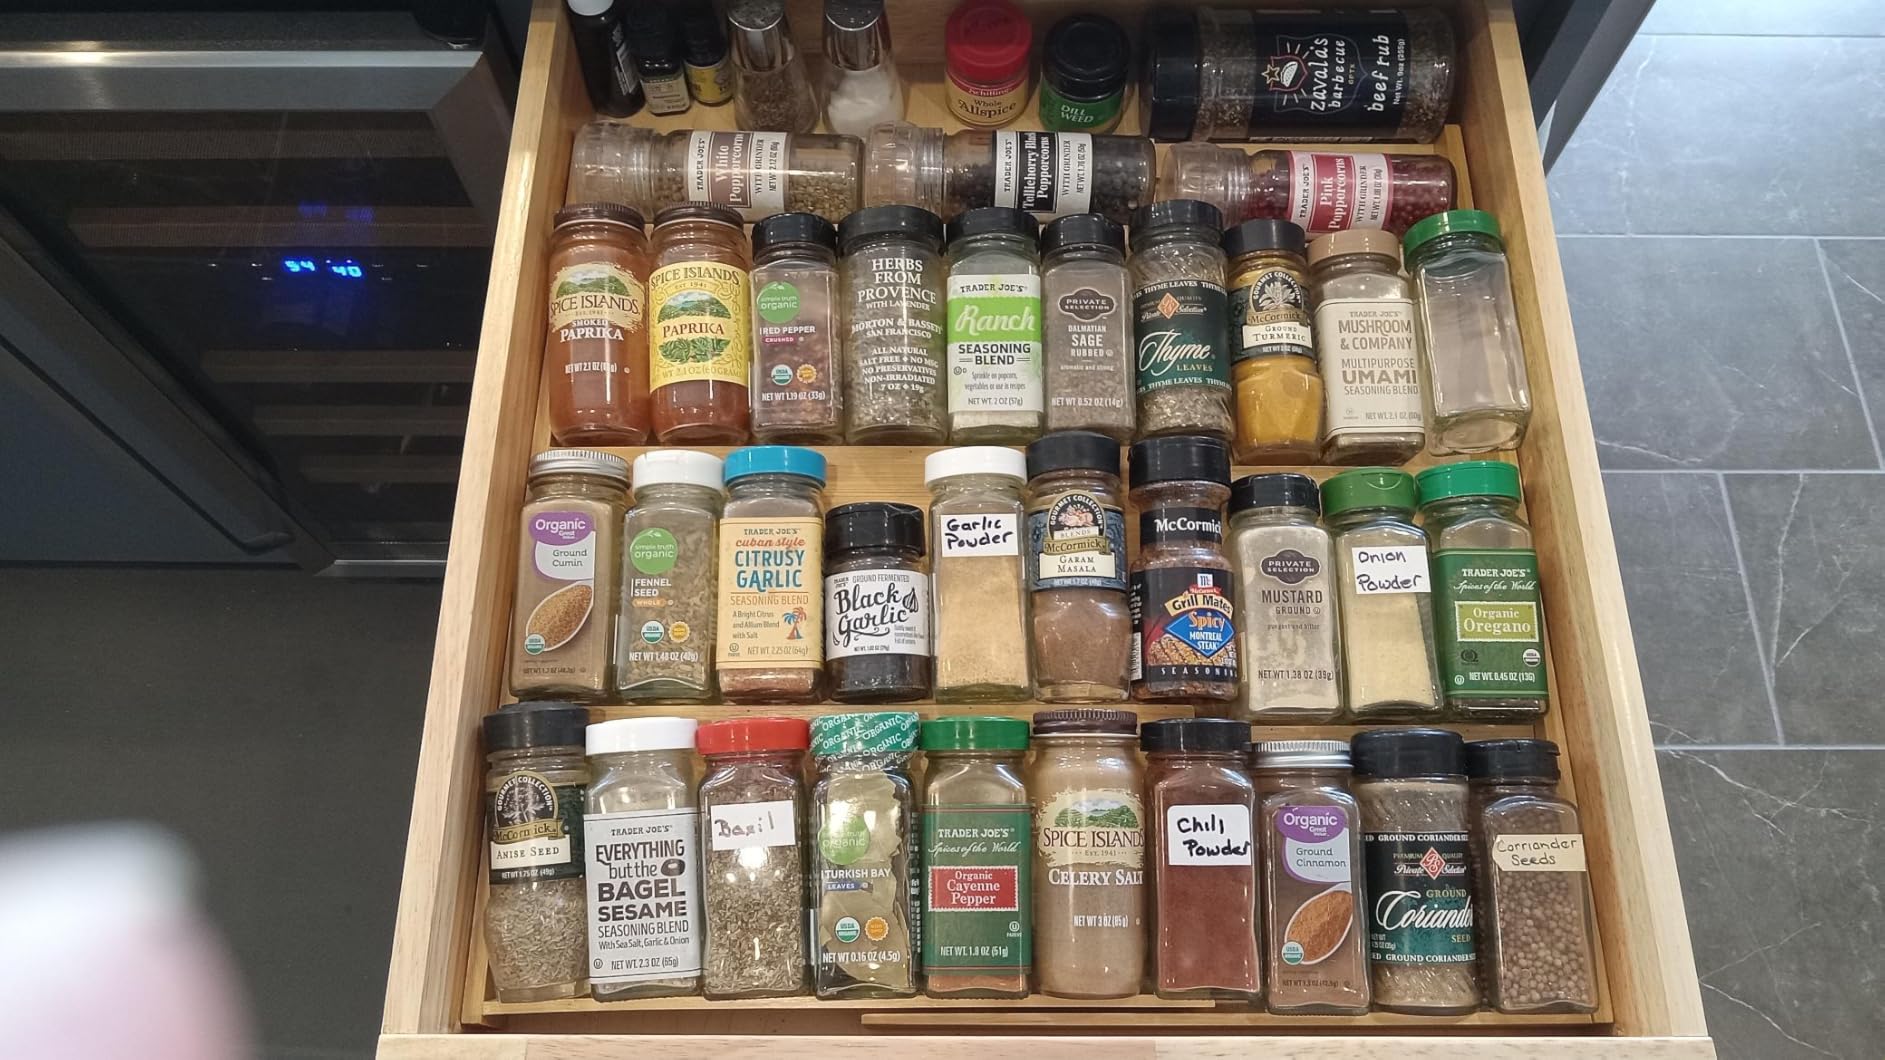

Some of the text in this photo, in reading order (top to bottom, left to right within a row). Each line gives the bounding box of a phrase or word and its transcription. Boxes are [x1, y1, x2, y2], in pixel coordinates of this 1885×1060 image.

[1328, 40, 1345, 108] barbecue
[1367, 34, 1390, 111] beef rub
[958, 99, 1017, 119] Allspice
[1061, 104, 1086, 116] DILL
[1061, 111, 1095, 123] WEED
[716, 145, 730, 183] White
[1004, 161, 1012, 192] TRADER
[1320, 177, 1334, 206] Pink
[1300, 189, 1309, 218] TRADER
[284, 260, 316, 273] 54
[331, 265, 363, 278] 40
[872, 258, 923, 272] HERBS
[651, 266, 741, 291] SPICE ISLANDS
[874, 271, 921, 285] FROM
[858, 286, 936, 304] PROVENCE
[960, 283, 1024, 293] TRADER JOE'S
[551, 294, 640, 318] SPICE ISLANDS
[761, 301, 798, 311] organic
[572, 319, 608, 327] SMOKED
[955, 304, 1036, 336] Ranch
[560, 327, 624, 343] PAPRIKA
[663, 322, 725, 338] PAPRIKA
[763, 326, 816, 336] RED PEPPER
[867, 328, 932, 339] SAN FRANCISCO
[1338, 320, 1412, 336] MUSHROOM
[1072, 334, 1103, 347] SAGE
[1340, 337, 1412, 350] & COMPANY
[958, 344, 1031, 354] SEASONING
[1071, 349, 1104, 357] RUBBED
[1139, 329, 1211, 376] Thyme
[975, 355, 1015, 365] BLEND
[1341, 358, 1415, 369] MULTIPURPOSE
[1177, 363, 1213, 372] LEAVES
[1342, 370, 1417, 385] UMAMI
[1344, 386, 1418, 395] SEASONING BLEND
[1050, 496, 1071, 525] GOURMET
[535, 518, 586, 534] Organic
[947, 516, 1002, 531] Garlic
[735, 536, 806, 549] cuban style
[945, 532, 1013, 550] Powder
[1046, 540, 1101, 553] McCormick
[634, 549, 675, 559] organic
[735, 550, 805, 567] CITRUSY
[1060, 555, 1094, 564] GARAM
[1358, 551, 1407, 563] Onion
[552, 559, 583, 567] Cumin
[1057, 565, 1096, 573] MASALA
[1462, 568, 1526, 578] TRADER JOE'S
[635, 578, 671, 587] FENNEL
[736, 569, 803, 592] GARLIC
[1357, 574, 1422, 591] Powder
[634, 588, 659, 597] SEED
[833, 582, 902, 615] Black
[1262, 590, 1323, 604] MUSTARD
[730, 594, 809, 606] SEASONING BLEND
[1172, 595, 1231, 614] Grill Mates
[1276, 606, 1311, 615] GROUND
[1473, 607, 1519, 619] Organic
[1188, 611, 1226, 632] Spicy
[1463, 618, 1531, 635] Oregano
[1189, 631, 1223, 642] MONTREAL
[1197, 640, 1218, 651] STEAK
[862, 715, 905, 740] ORGANIC
[862, 733, 902, 757] ORGANIC
[518, 776, 552, 806] COLLECTION
[714, 810, 774, 837] Basil
[1177, 813, 1225, 835] Chili
[1283, 812, 1338, 829] Organic
[611, 825, 670, 837] TRADER JOE'S
[938, 828, 1009, 838] TRADER JOE'S
[1043, 827, 1088, 847] SPICE
[1378, 834, 1416, 842] GROUND
[1182, 838, 1252, 857] Powder
[1296, 848, 1333, 856] Ground
[1496, 837, 1577, 853] Corriander
[496, 846, 560, 860] ANISE SEED
[595, 839, 685, 866] EVERYTHING
[1511, 852, 1556, 866] Seeds
[609, 859, 657, 880] but the
[1296, 858, 1347, 868] Cinnamon
[825, 867, 891, 879] TURKISH BAY
[955, 870, 993, 881] Organic
[1048, 868, 1112, 885] CELERY
[598, 878, 686, 902] BAGEL
[947, 879, 1000, 893] Cayenne
[951, 893, 996, 907] Pepper
[1426, 889, 1466, 898] GROUND
[598, 901, 687, 922] SESAME
[1376, 891, 1473, 930] Coriand
[598, 919, 689, 938] SEASONING BLEND
[644, 937, 663, 947] Garlic
[670, 935, 690, 945] Onion
[611, 960, 624, 970] NET
[639, 958, 650, 968] 2.3
[651, 957, 660, 967] OZ
[823, 952, 837, 964] NET
[838, 951, 849, 964] WT
[868, 951, 877, 962] OZ
